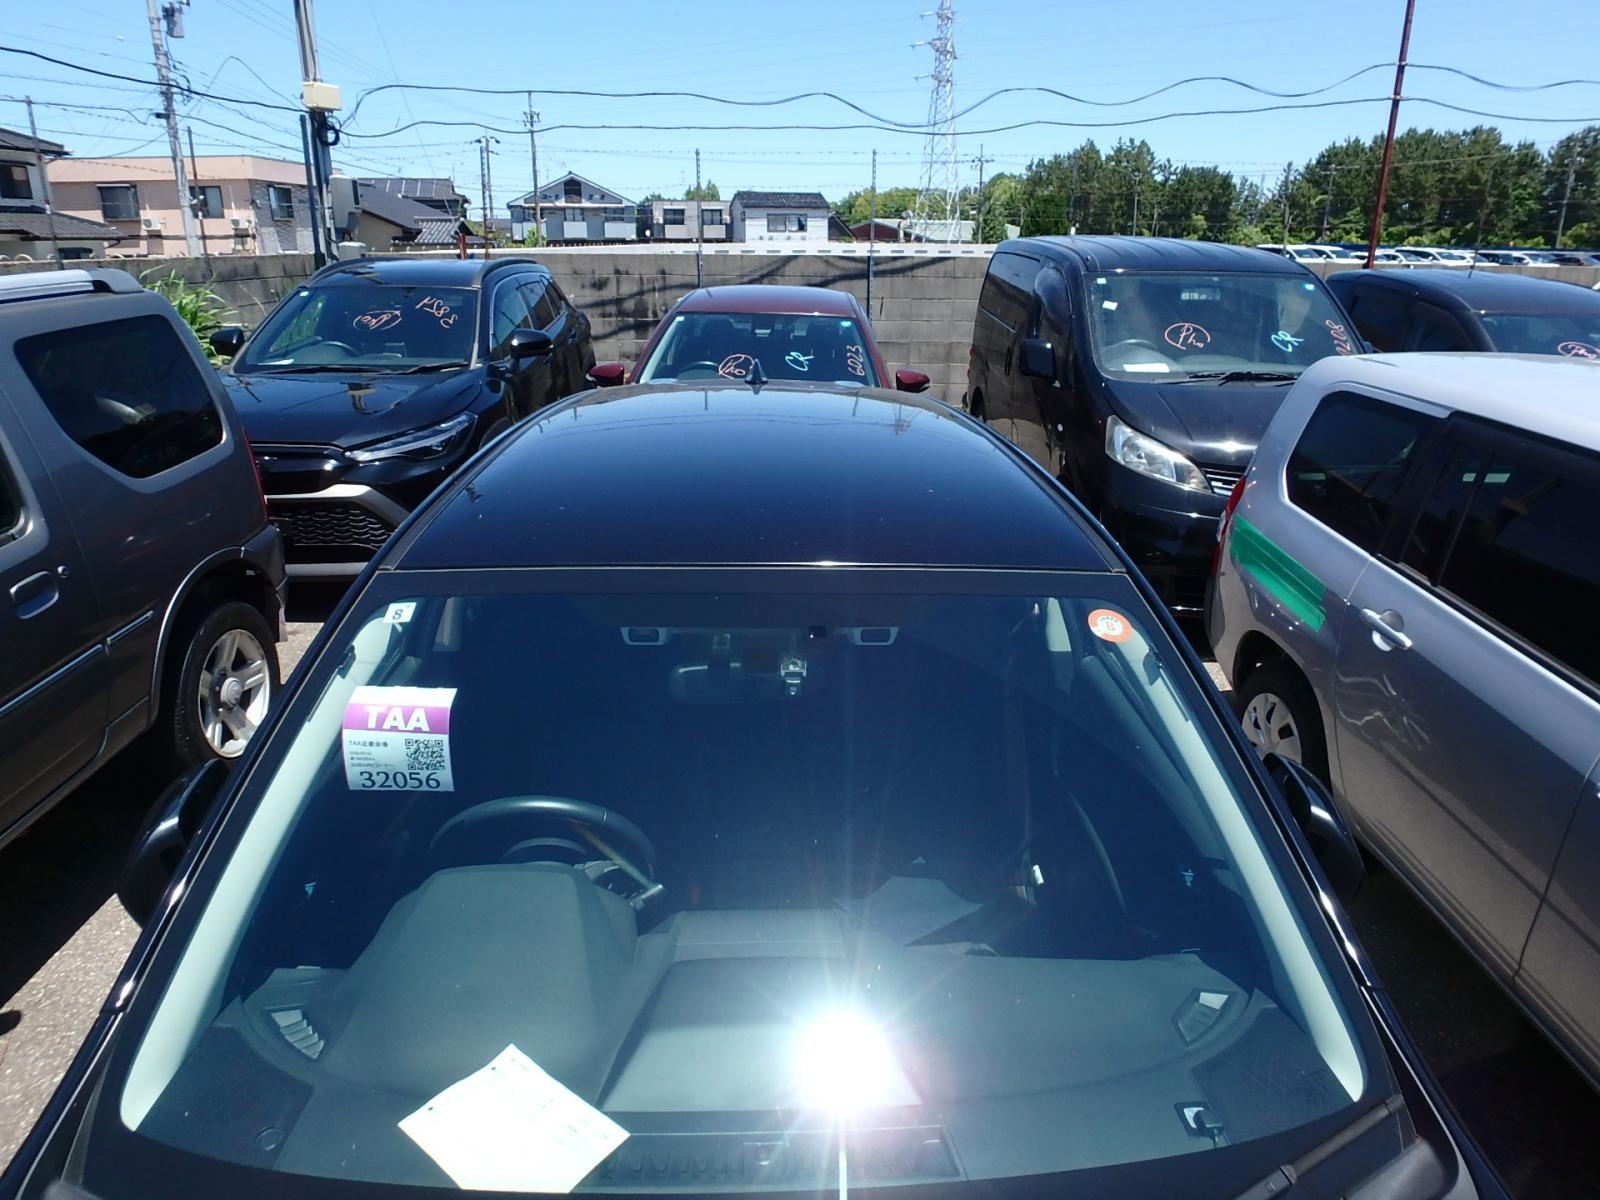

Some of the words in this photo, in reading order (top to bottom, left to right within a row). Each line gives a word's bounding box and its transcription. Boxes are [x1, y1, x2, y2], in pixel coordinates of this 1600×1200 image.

[847, 345, 866, 376] 6023
[392, 608, 403, 620] 8
[363, 705, 431, 732] TAA
[359, 771, 441, 789] 32056
